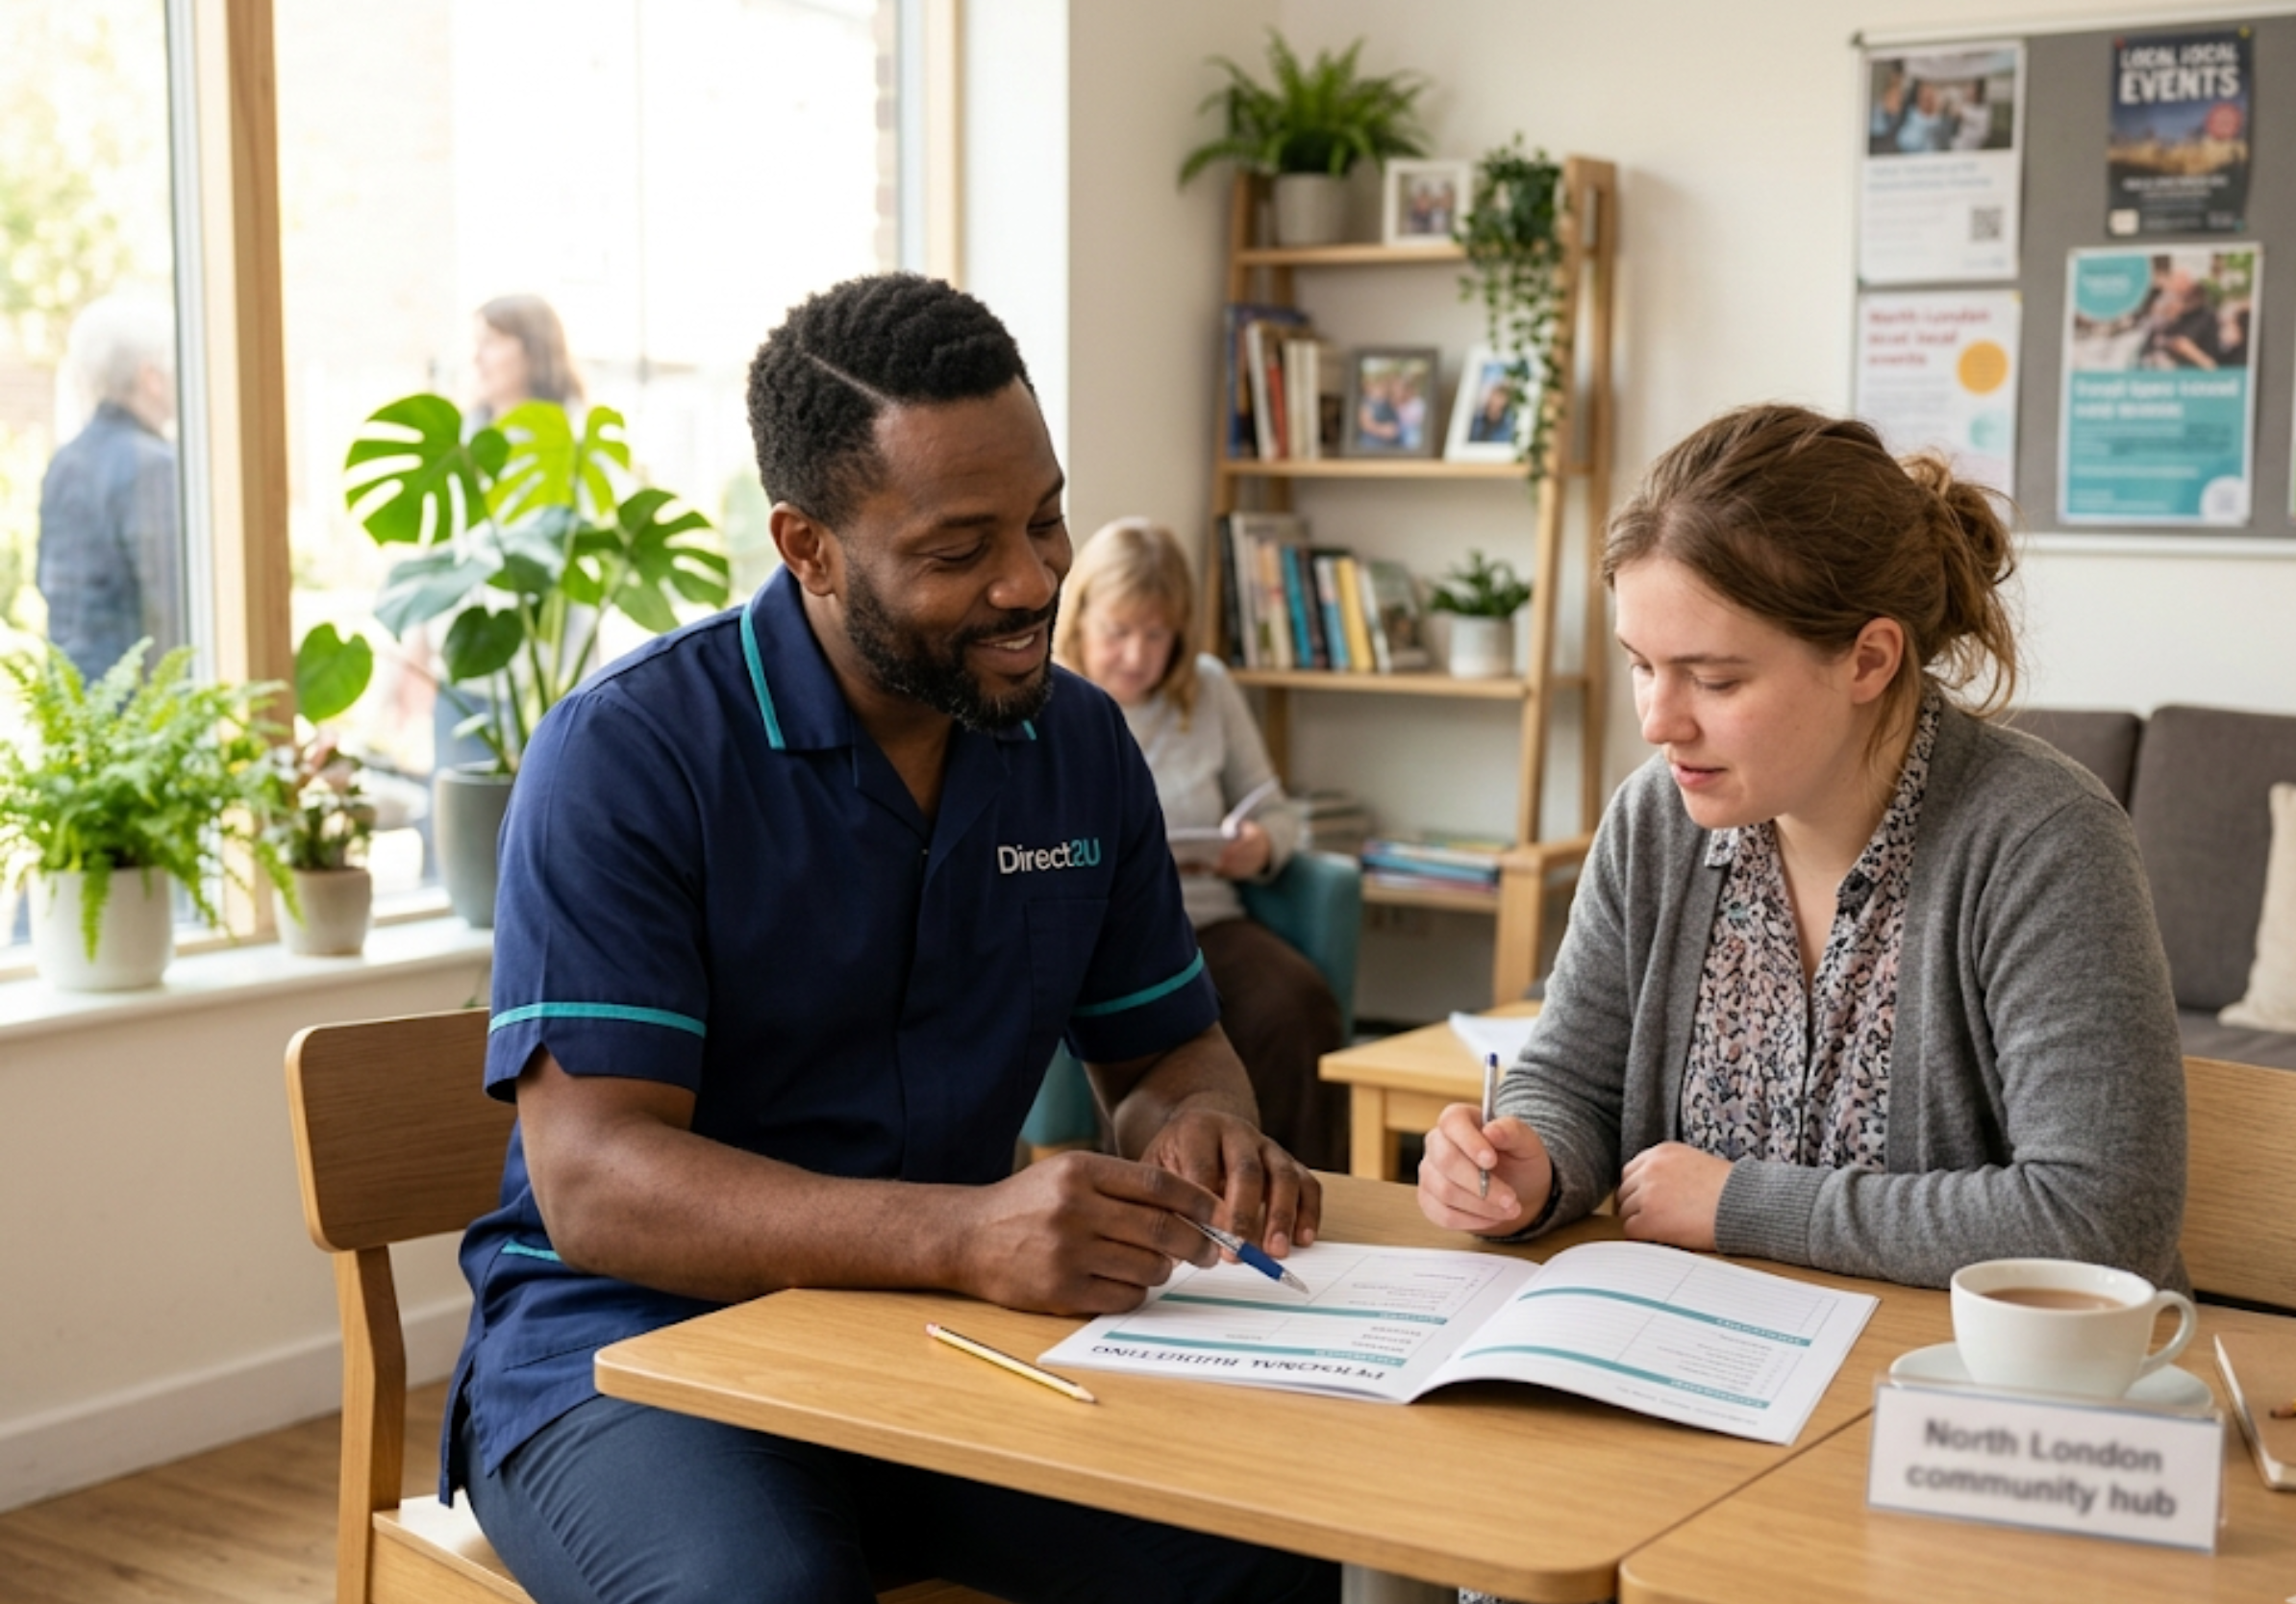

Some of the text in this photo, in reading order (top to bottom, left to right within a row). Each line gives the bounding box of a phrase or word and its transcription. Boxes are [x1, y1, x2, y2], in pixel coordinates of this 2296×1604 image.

[2121, 45, 2175, 69] LOCAL
[2120, 66, 2240, 105] EVENTS
[997, 838, 1102, 874] Direct2U
[1925, 1417, 2163, 1474] North London
[1906, 1463, 2178, 1519] community hub
